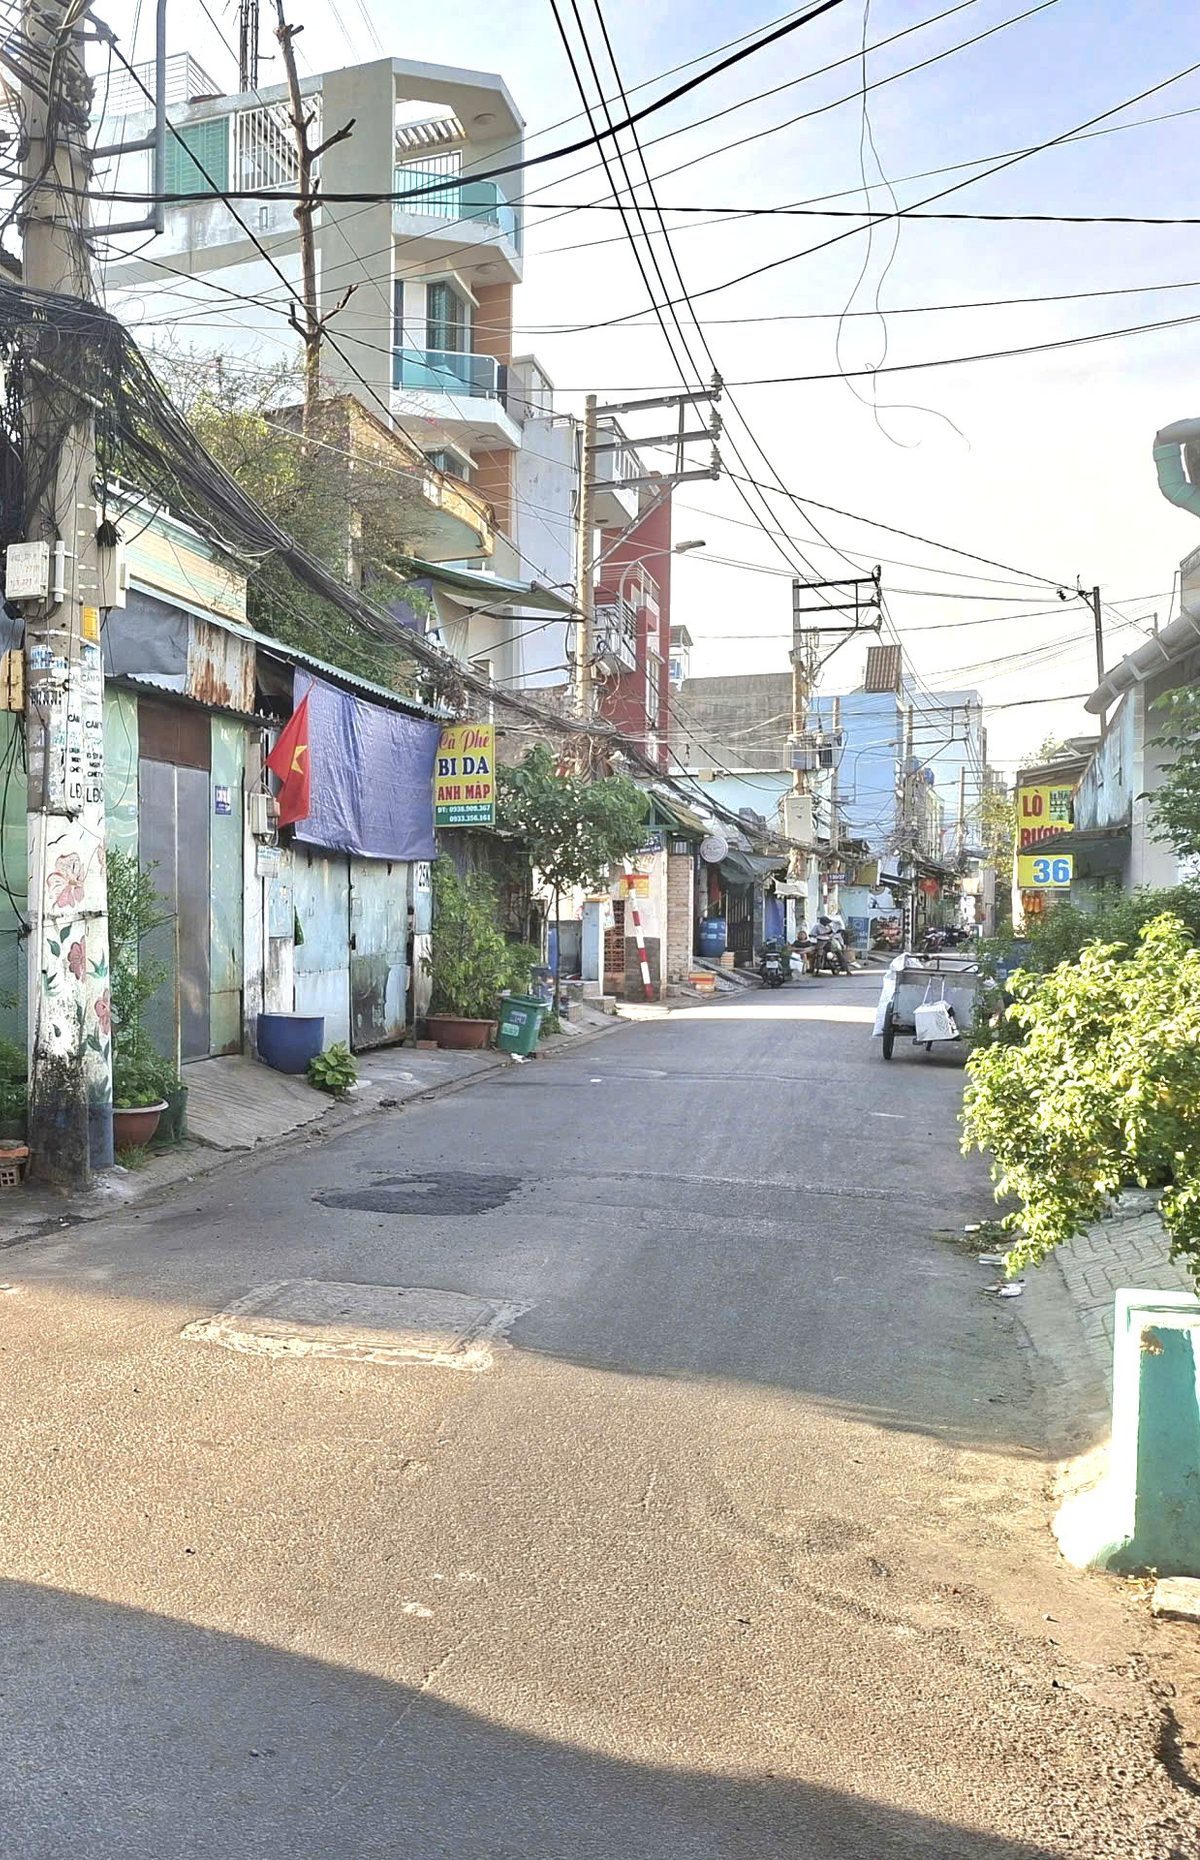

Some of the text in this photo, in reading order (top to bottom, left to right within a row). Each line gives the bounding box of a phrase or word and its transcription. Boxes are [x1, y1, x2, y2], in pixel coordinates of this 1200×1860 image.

[461, 728, 490, 753] Phê
[438, 755, 490, 776] BI DA
[437, 780, 491, 803] ANH MẬP
[1022, 789, 1043, 817] LÒ
[1032, 858, 1070, 884] 36
